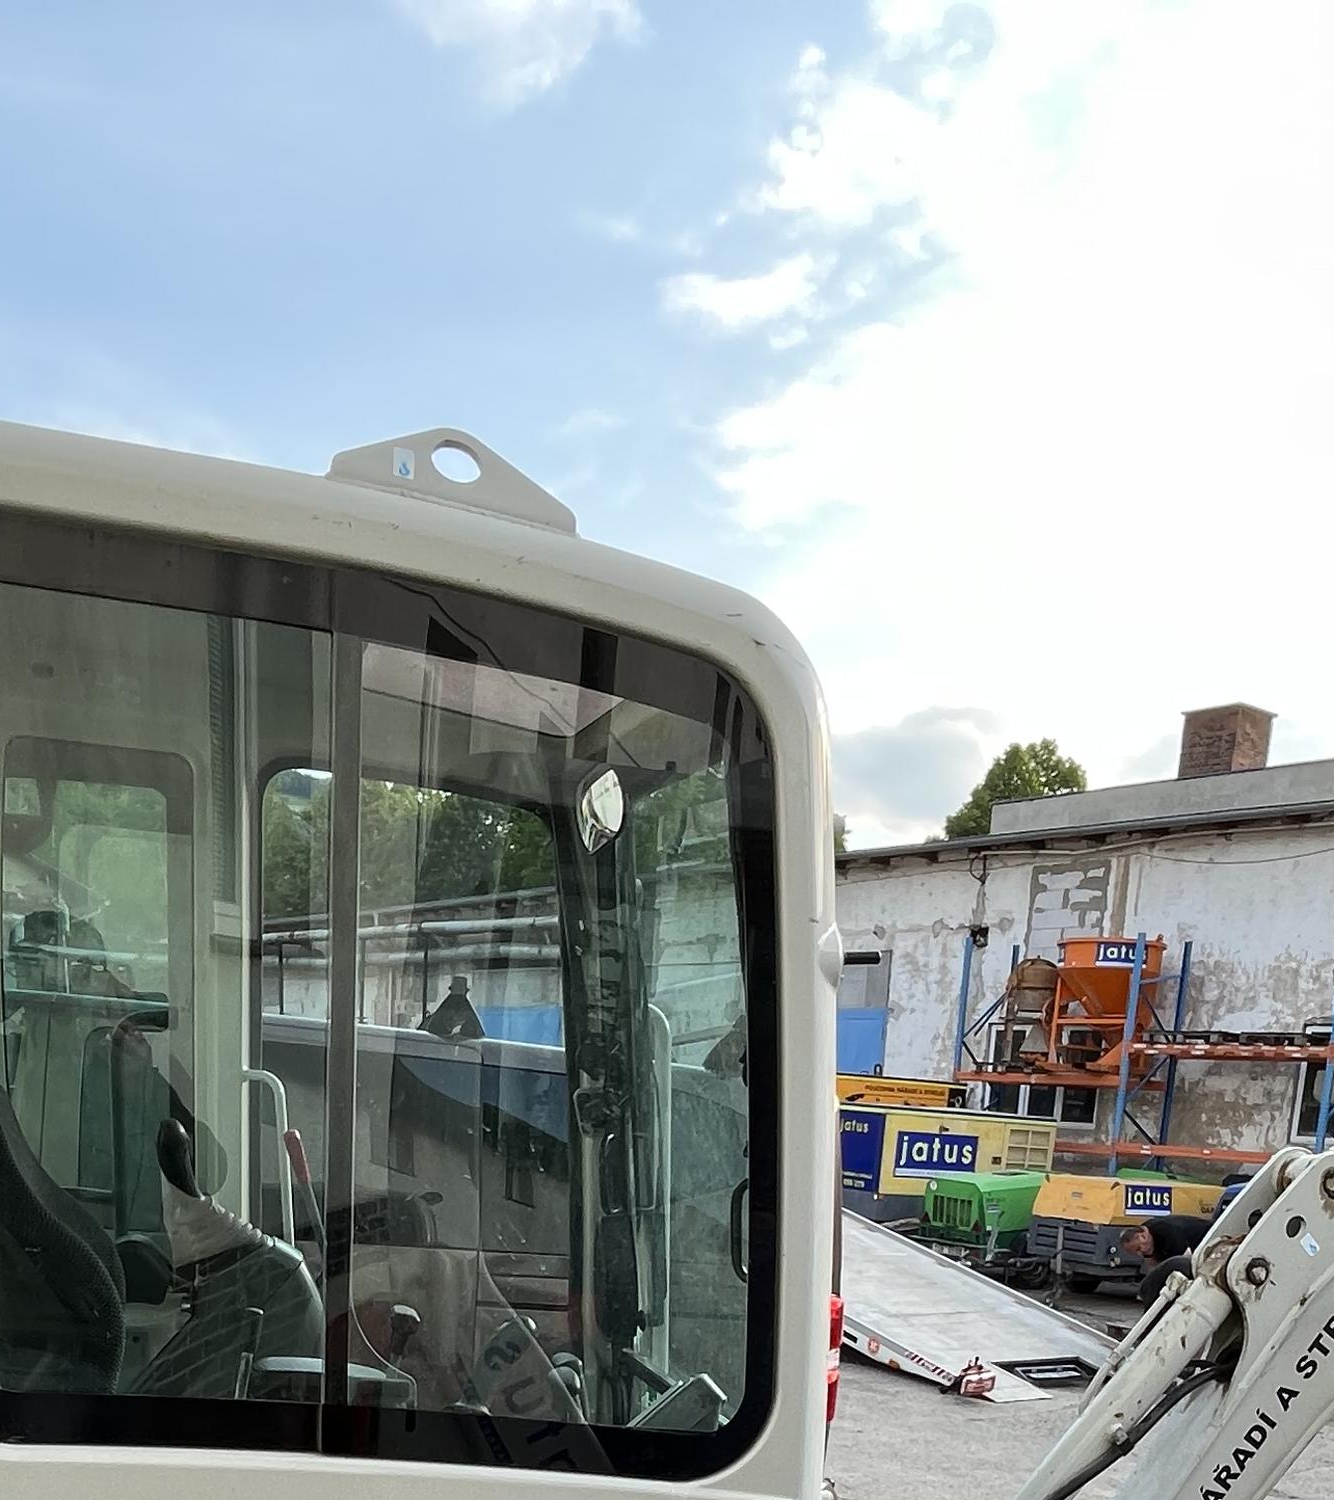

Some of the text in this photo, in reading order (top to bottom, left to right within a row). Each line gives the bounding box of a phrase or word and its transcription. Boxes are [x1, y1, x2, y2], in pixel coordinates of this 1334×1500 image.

[899, 1135, 974, 1166] jatus
[1127, 1187, 1170, 1208] jatus
[1276, 1385, 1301, 1412] A
